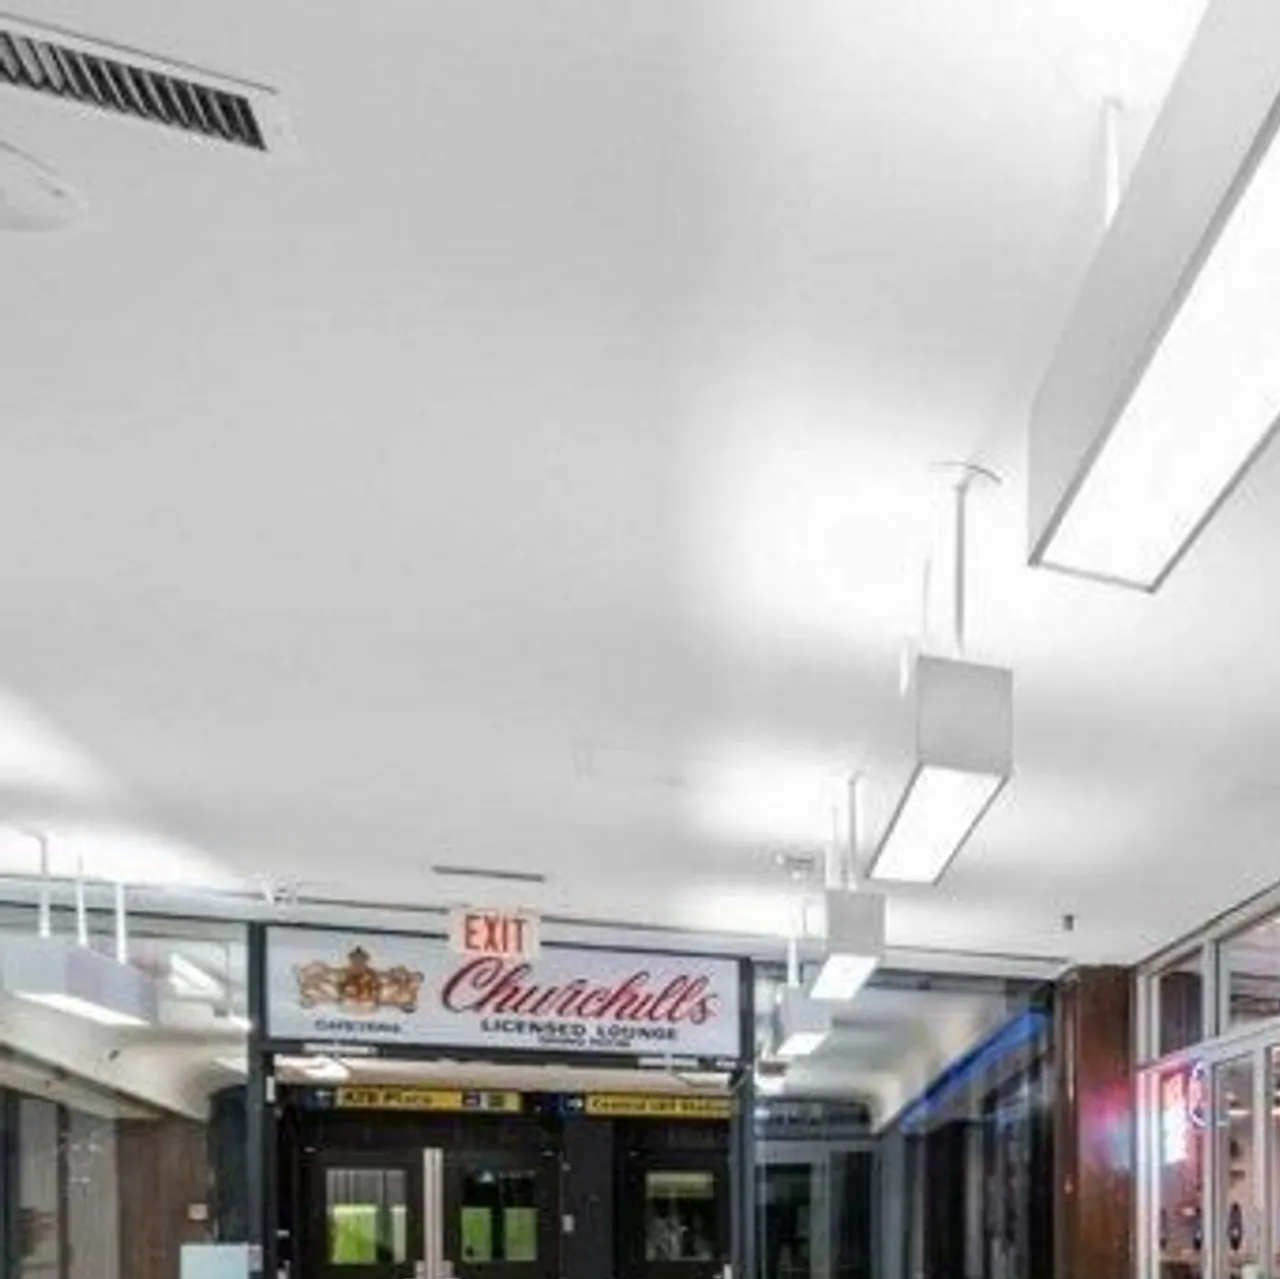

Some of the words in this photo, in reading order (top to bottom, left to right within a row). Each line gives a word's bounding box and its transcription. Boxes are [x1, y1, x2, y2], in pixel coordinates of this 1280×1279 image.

[464, 914, 528, 953] EXIT
[480, 1018, 587, 1037] LICENSED
[596, 1026, 678, 1041] LOUNGE
